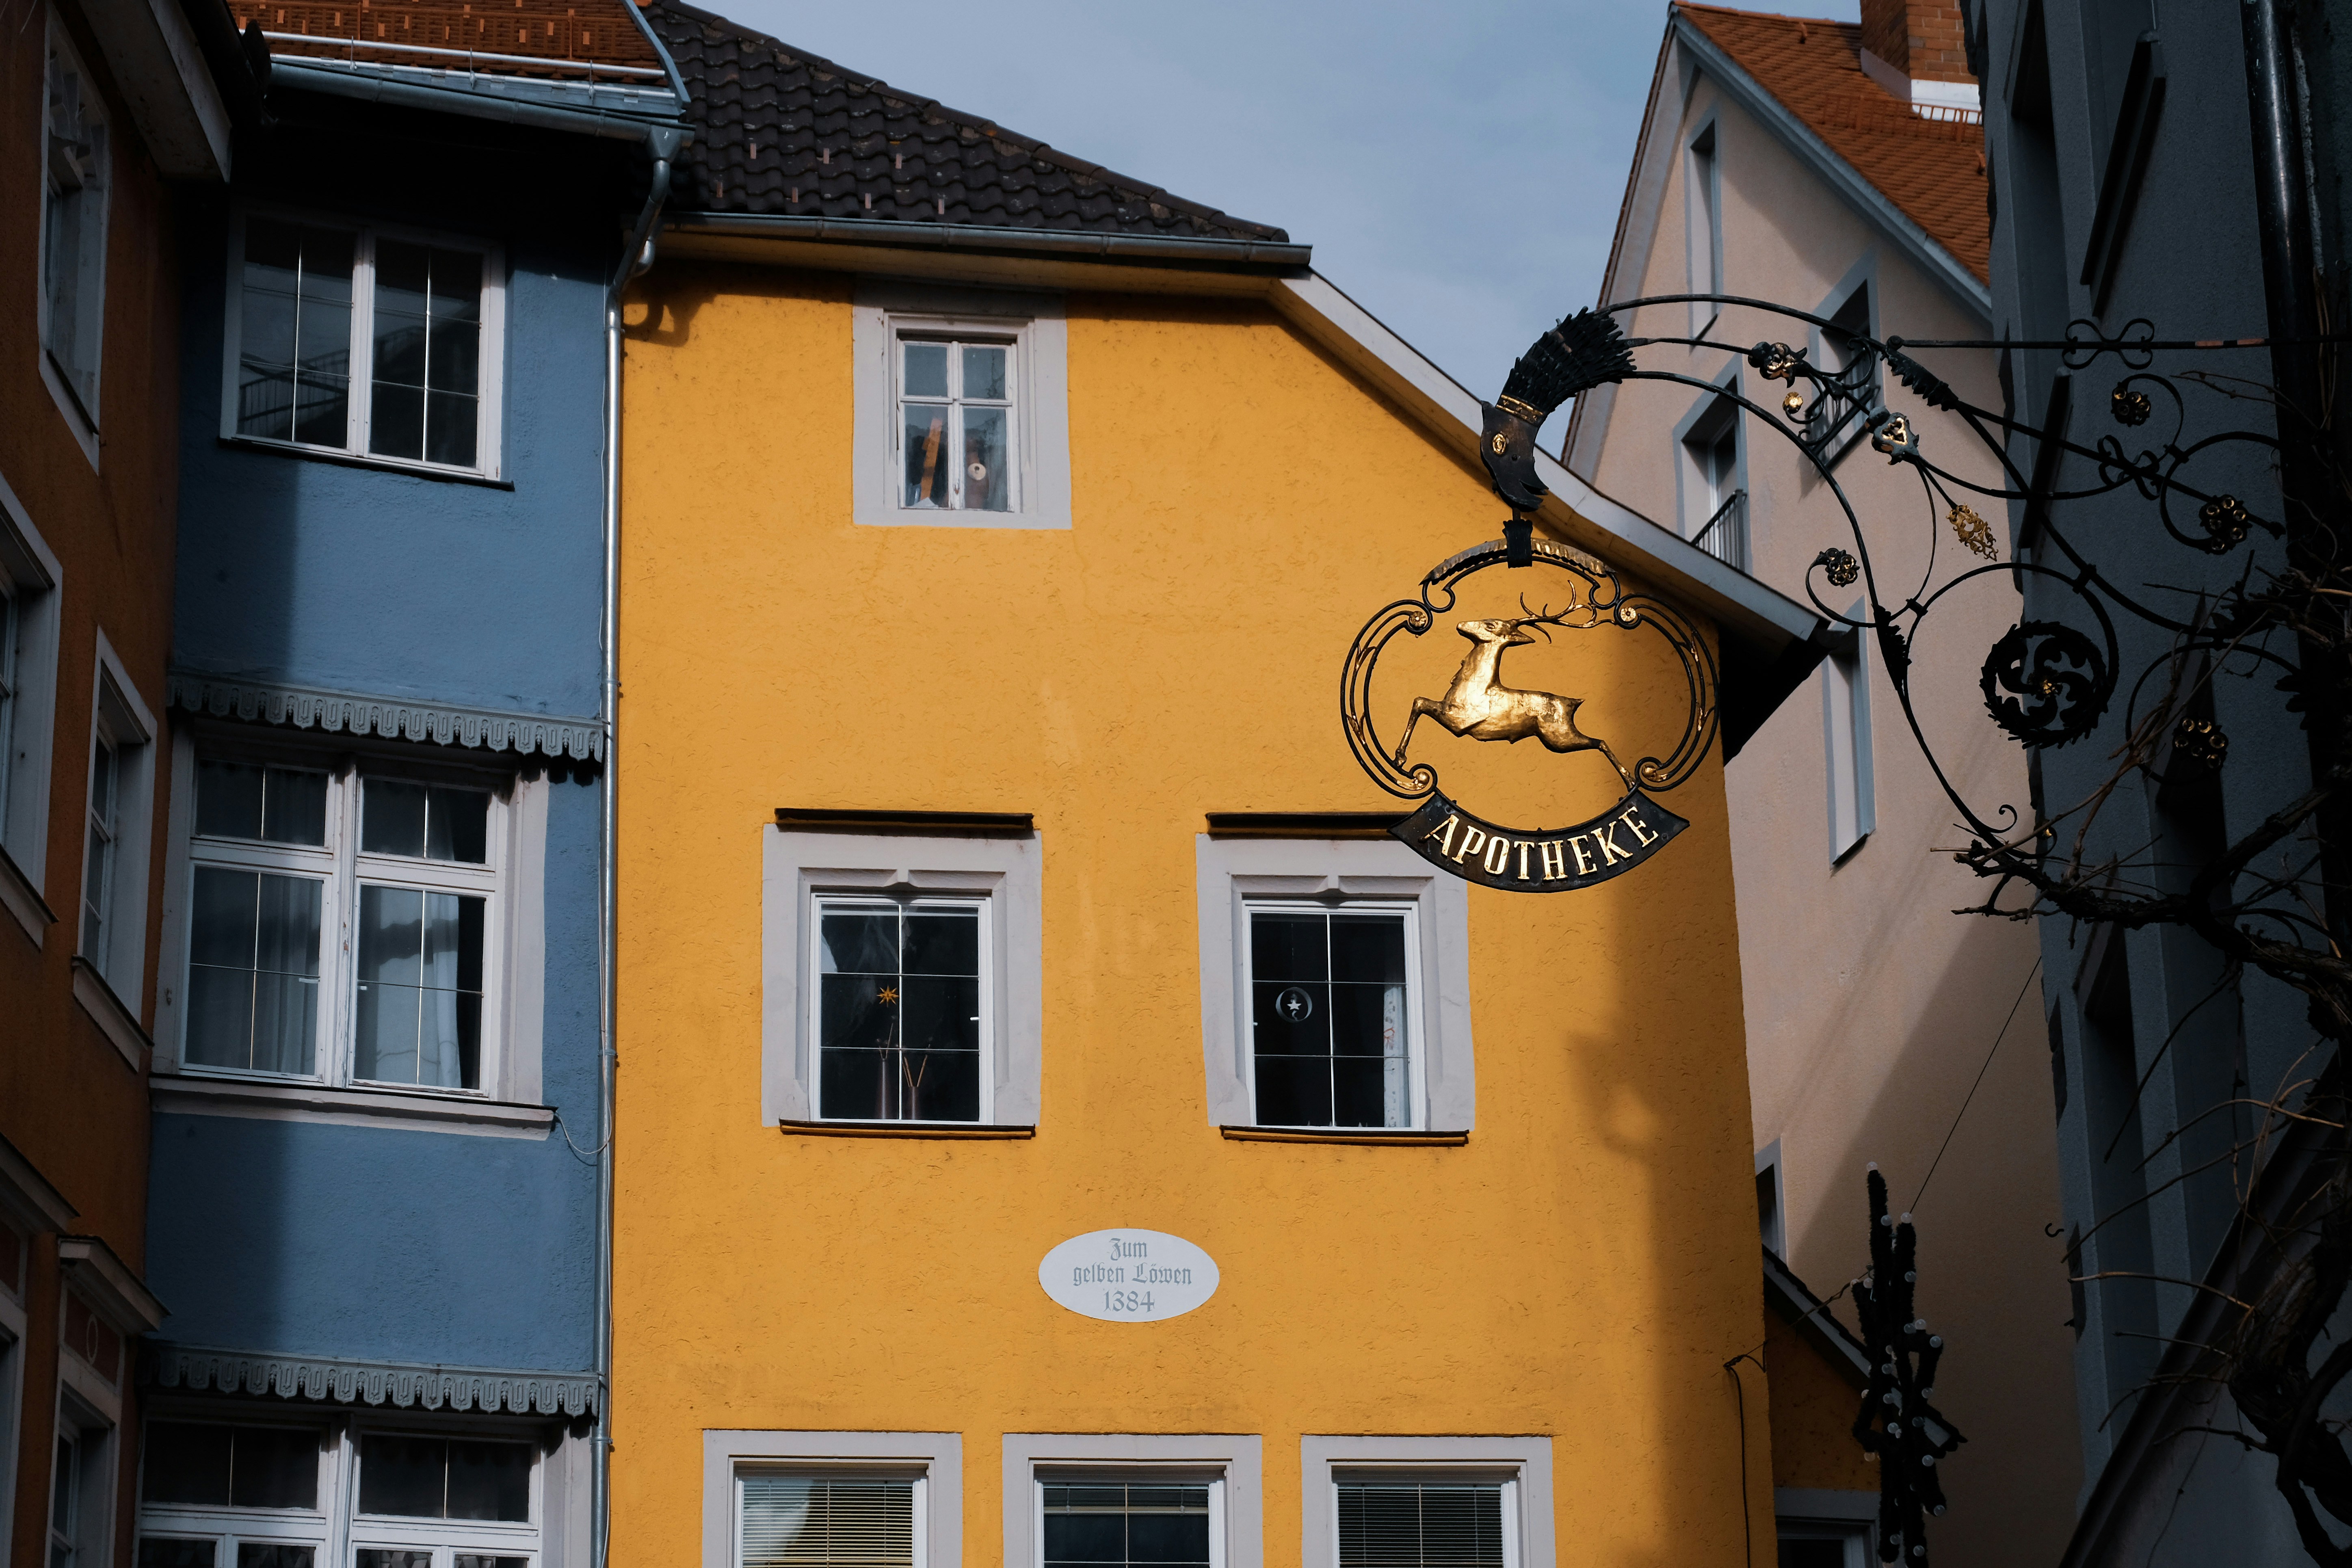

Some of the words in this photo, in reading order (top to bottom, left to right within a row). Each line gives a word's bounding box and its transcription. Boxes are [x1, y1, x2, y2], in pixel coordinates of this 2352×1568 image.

[1419, 806, 1658, 880] APOTHEKE
[1109, 1238, 1147, 1261] Zum
[1073, 1262, 1124, 1287] gelben
[1132, 1262, 1192, 1285] Löwen
[1103, 1290, 1155, 1313] 1384
